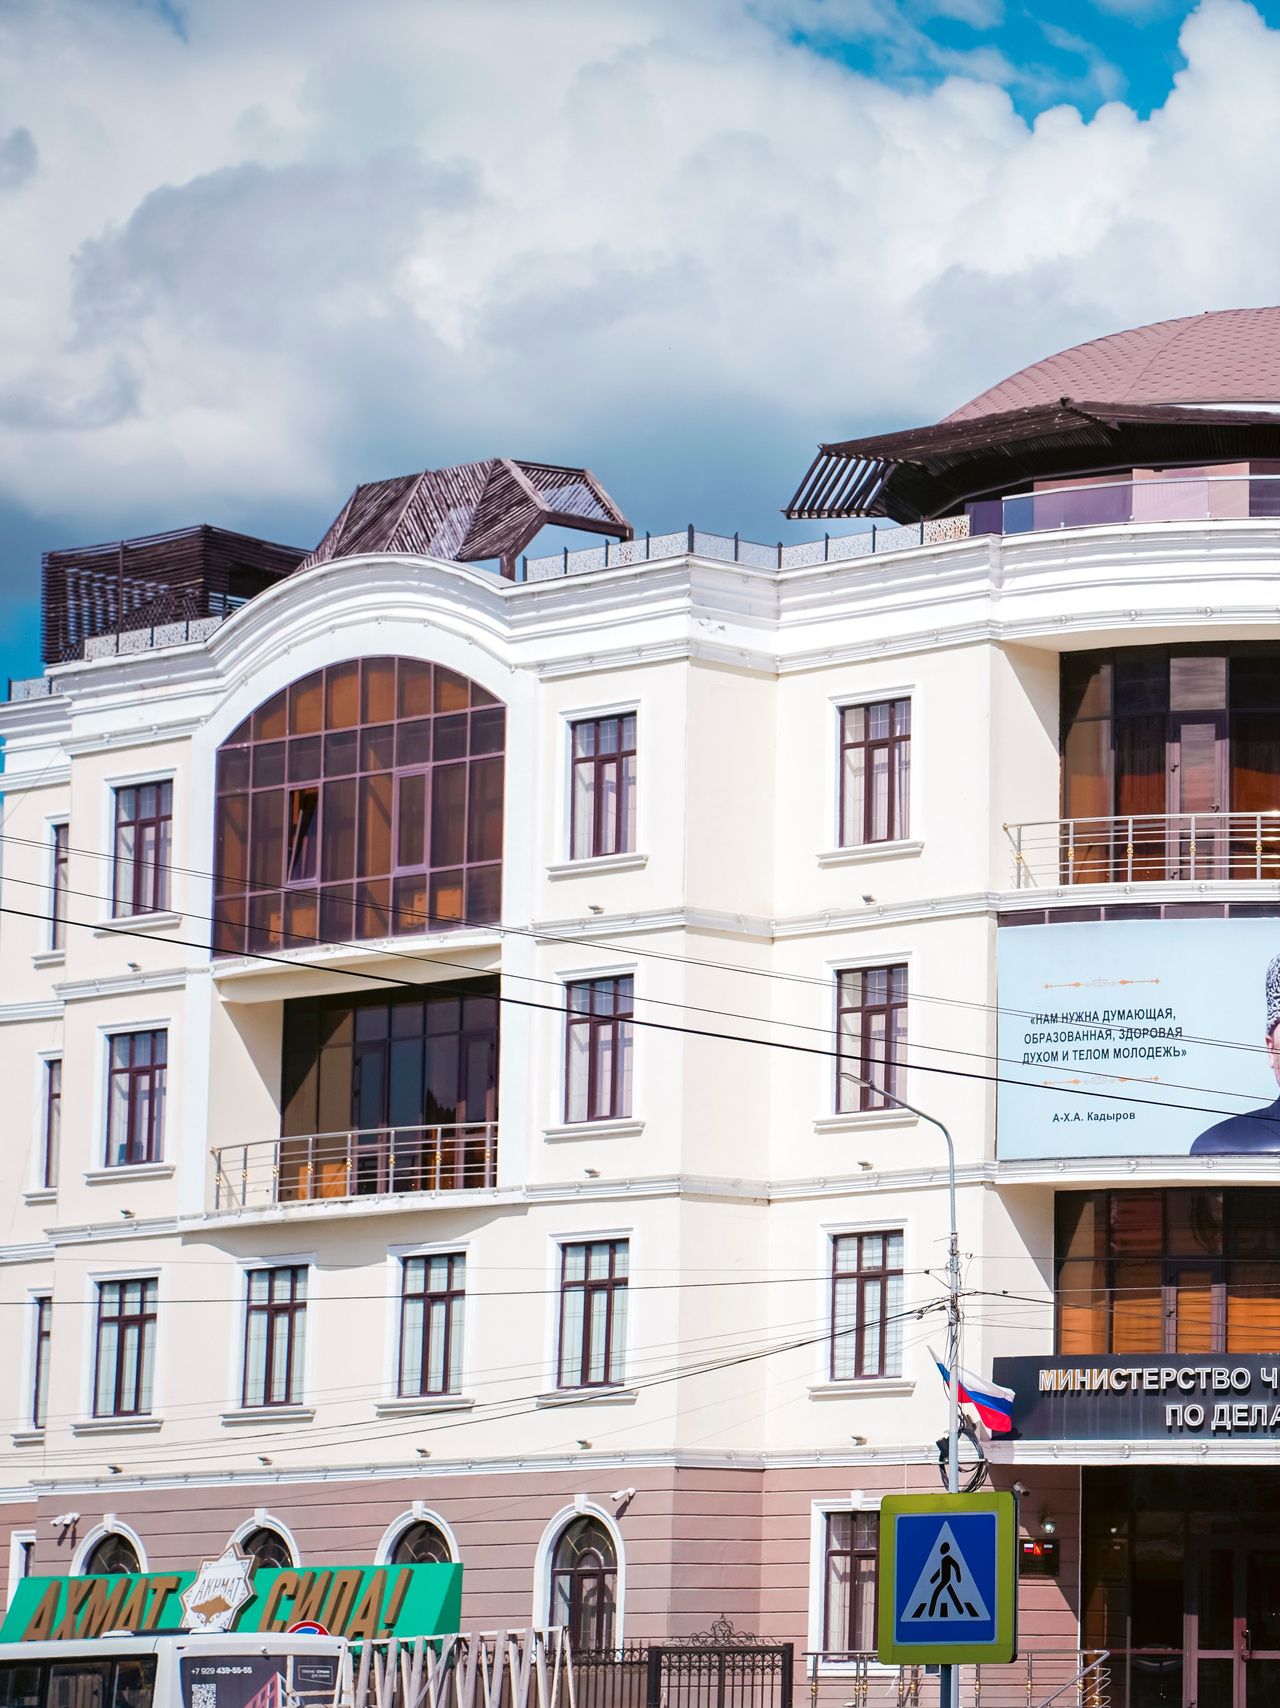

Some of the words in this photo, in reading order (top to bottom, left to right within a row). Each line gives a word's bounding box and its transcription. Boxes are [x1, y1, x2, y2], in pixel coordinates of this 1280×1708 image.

[1030, 1012, 1058, 1026] «НАМ
[1061, 1010, 1100, 1024] НУЖНА
[1102, 1008, 1176, 1024] ДУМАЮЩАЯ,
[1024, 1029, 1116, 1044] ОБРАЗОВАННАЯ,
[1118, 1027, 1183, 1041] ЗДОРОВАЯ
[1022, 1050, 1059, 1065] ДУХОМ
[1062, 1051, 1069, 1062] И
[1072, 1048, 1110, 1061] ТЕЛОМ
[1113, 1046, 1187, 1060] МОЛОДЕЖЬ»
[1052, 1112, 1084, 1123] А-Х.А.
[1087, 1111, 1136, 1122] Кадыров
[1038, 1367, 1251, 1391] МИНИСТЕРСТВО
[1165, 1404, 1205, 1427] ПО
[21, 1576, 181, 1641] АХМАТ
[191, 1667, 200, 1675] +7
[216, 1666, 253, 1674] 439-55-55
